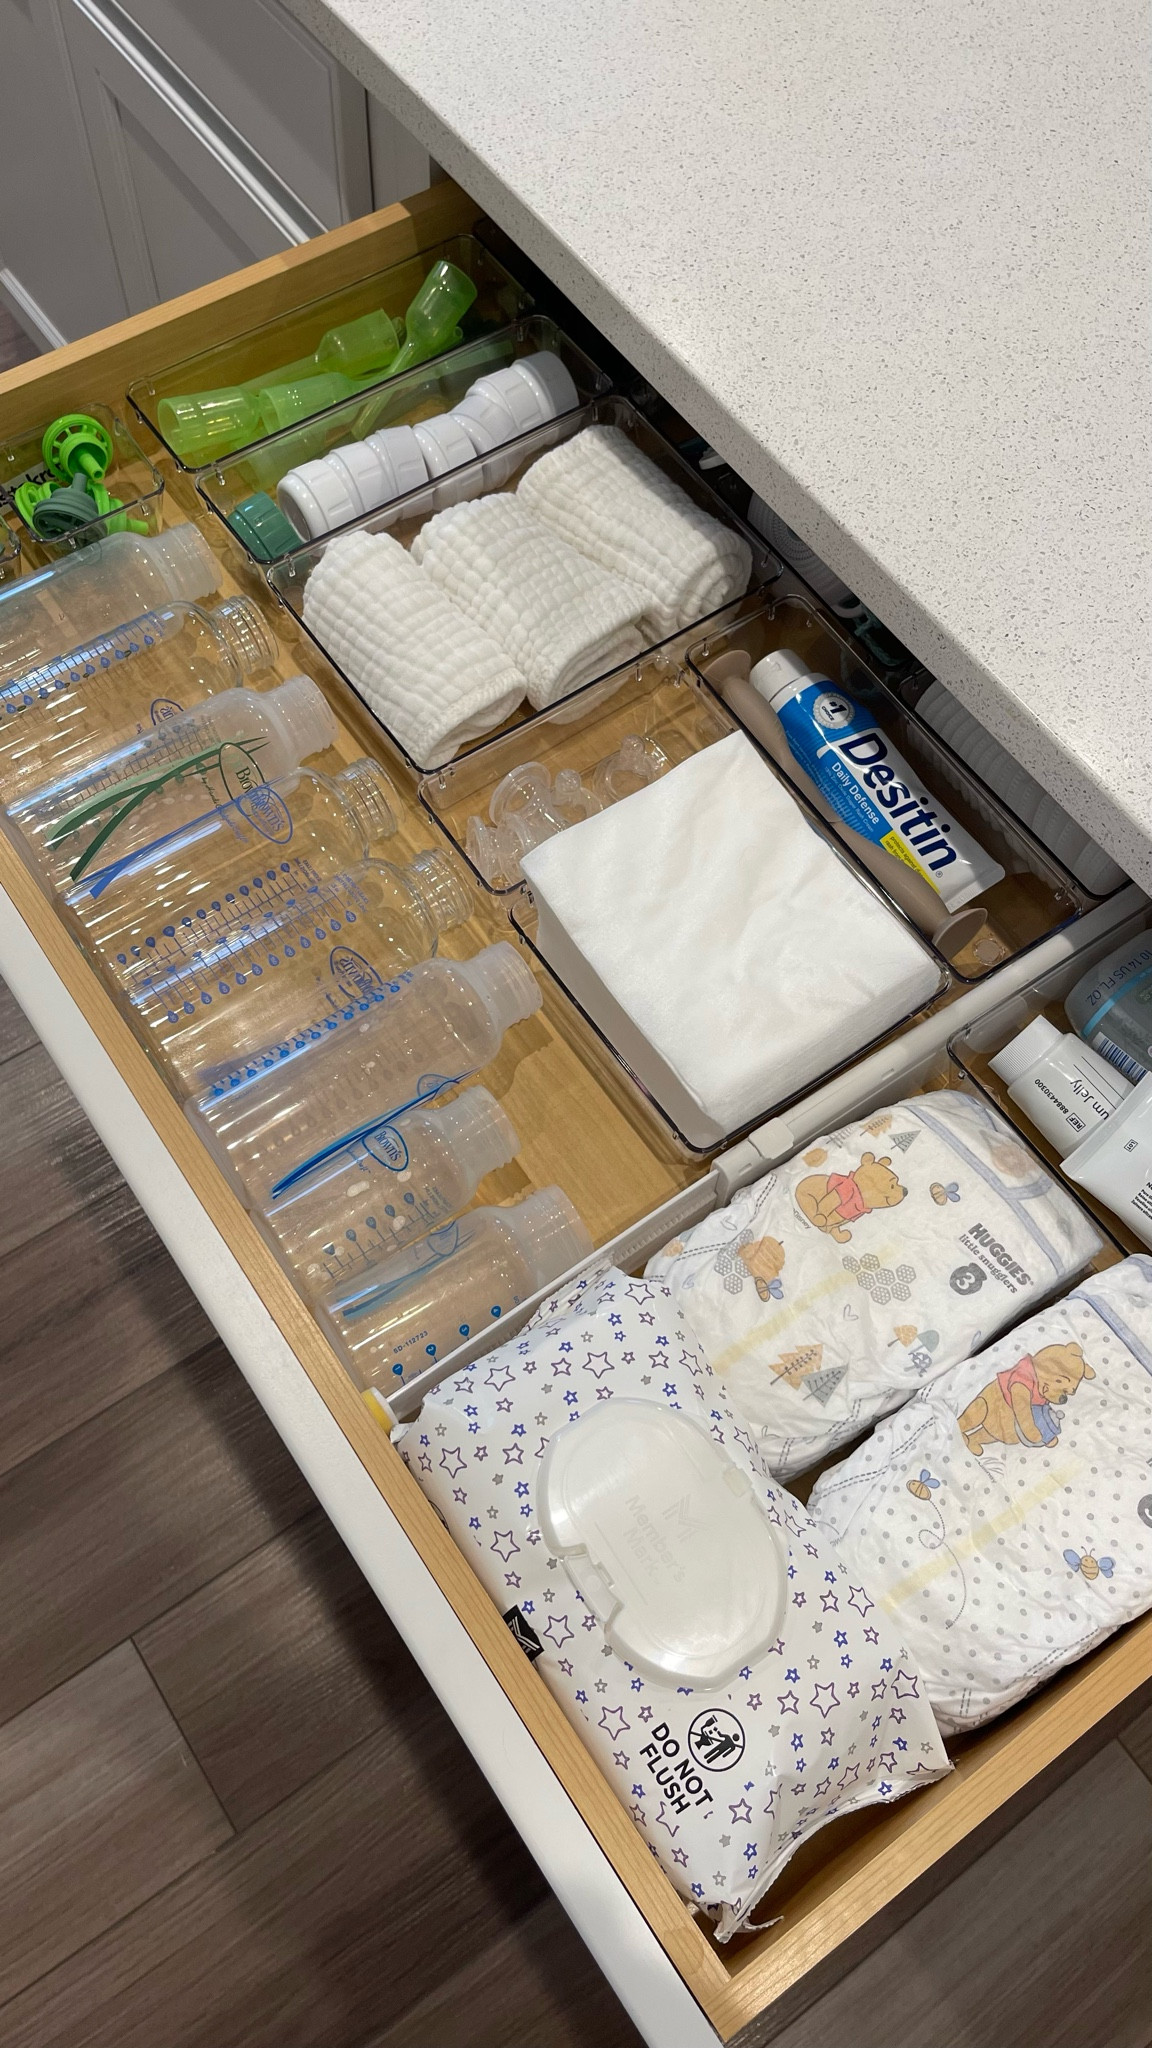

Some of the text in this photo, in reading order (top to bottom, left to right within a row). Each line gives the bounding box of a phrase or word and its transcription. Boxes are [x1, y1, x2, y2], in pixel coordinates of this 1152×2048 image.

[831, 762, 880, 824] Daily Defense
[1034, 1078, 1069, 1115] 8884430300
[1070, 1079, 1095, 1103] Jelly
[956, 1272, 976, 1290] 3
[958, 1234, 1018, 1294] little snugglers
[968, 1222, 1031, 1286] HUGGIES
[639, 1743, 691, 1815] FLUSH
[651, 1722, 714, 1806] DO NOT
